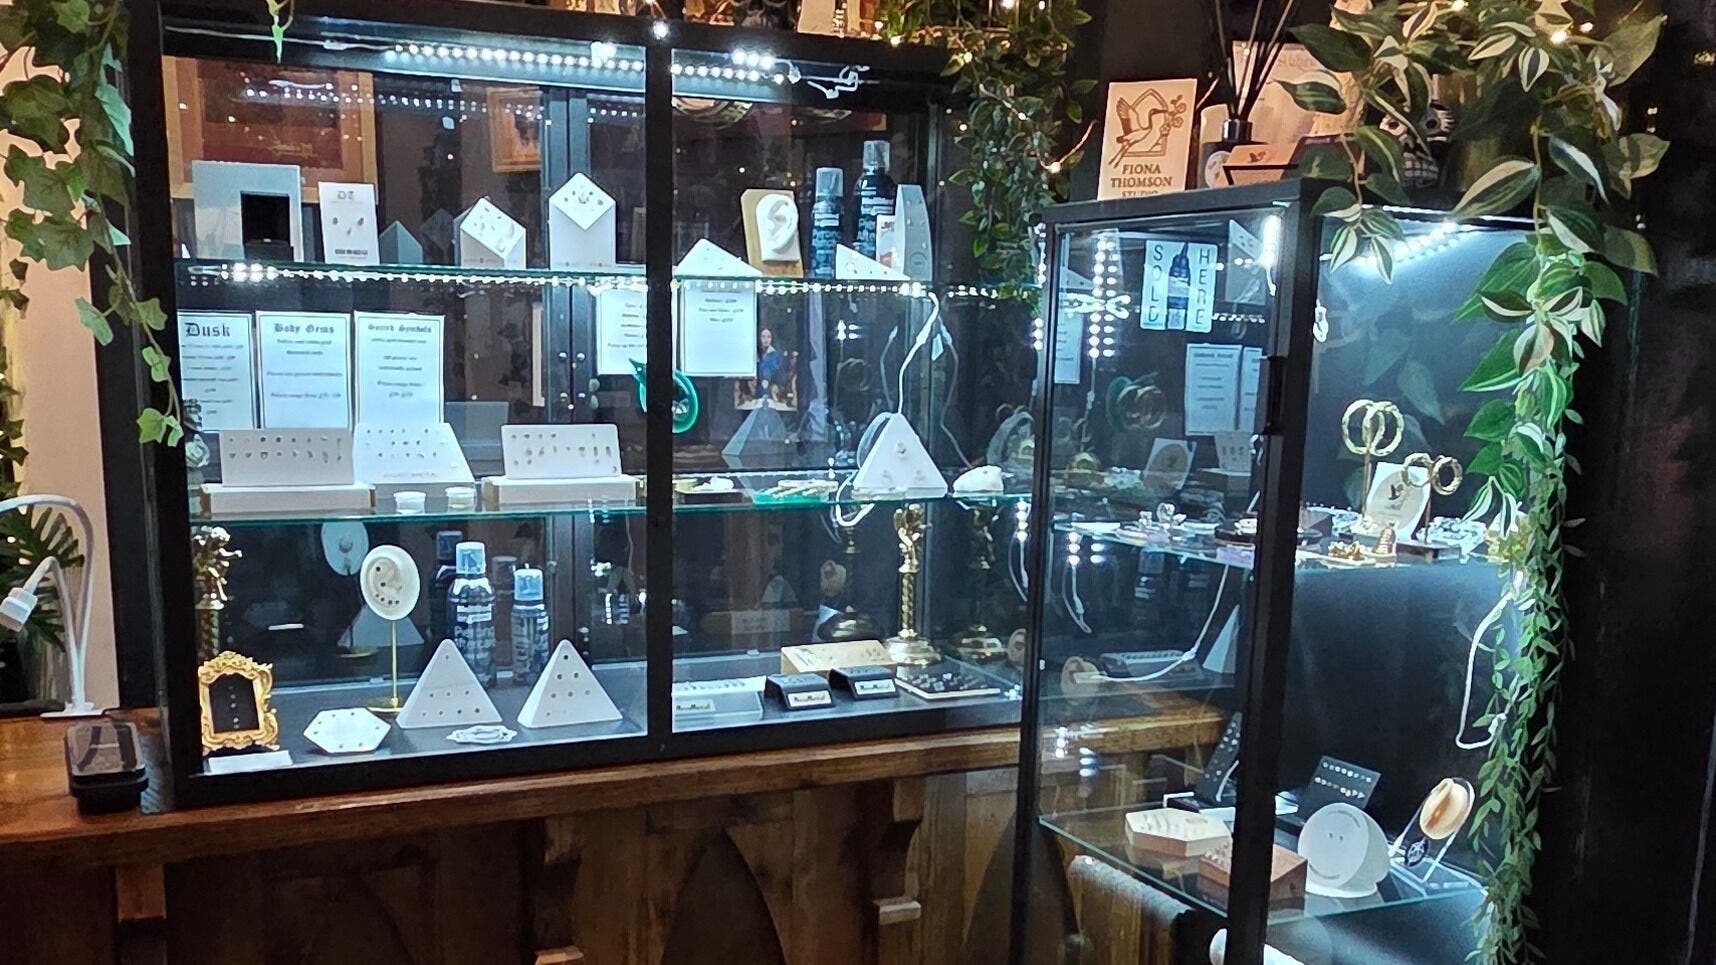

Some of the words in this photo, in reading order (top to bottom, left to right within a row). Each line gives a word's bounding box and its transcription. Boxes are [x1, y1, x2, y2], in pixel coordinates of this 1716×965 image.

[1122, 164, 1162, 175] FIONA
[1110, 176, 1173, 188] THOMSON
[1148, 244, 1164, 322] SOLD
[1195, 248, 1211, 325] HERE
[184, 322, 231, 337] Dusk
[274, 323, 301, 335] Body
